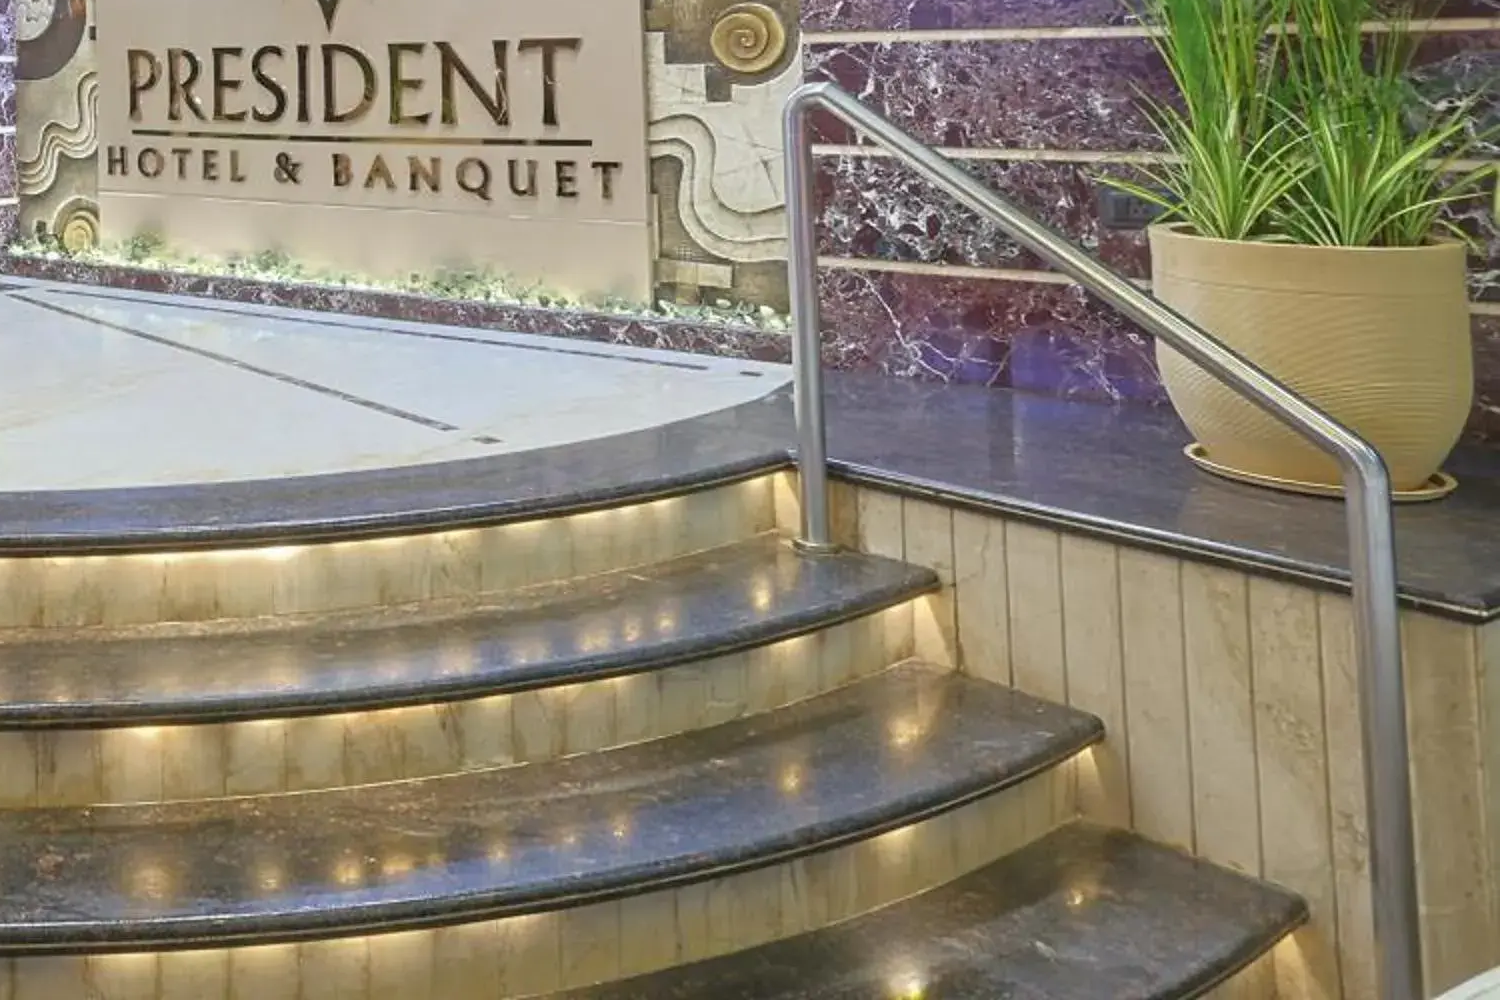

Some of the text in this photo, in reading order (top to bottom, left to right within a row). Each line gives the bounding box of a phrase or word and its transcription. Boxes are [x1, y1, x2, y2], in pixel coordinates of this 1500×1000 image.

[127, 37, 582, 126] PRESIDENT
[107, 146, 623, 200] HOTEL & BANQUET
